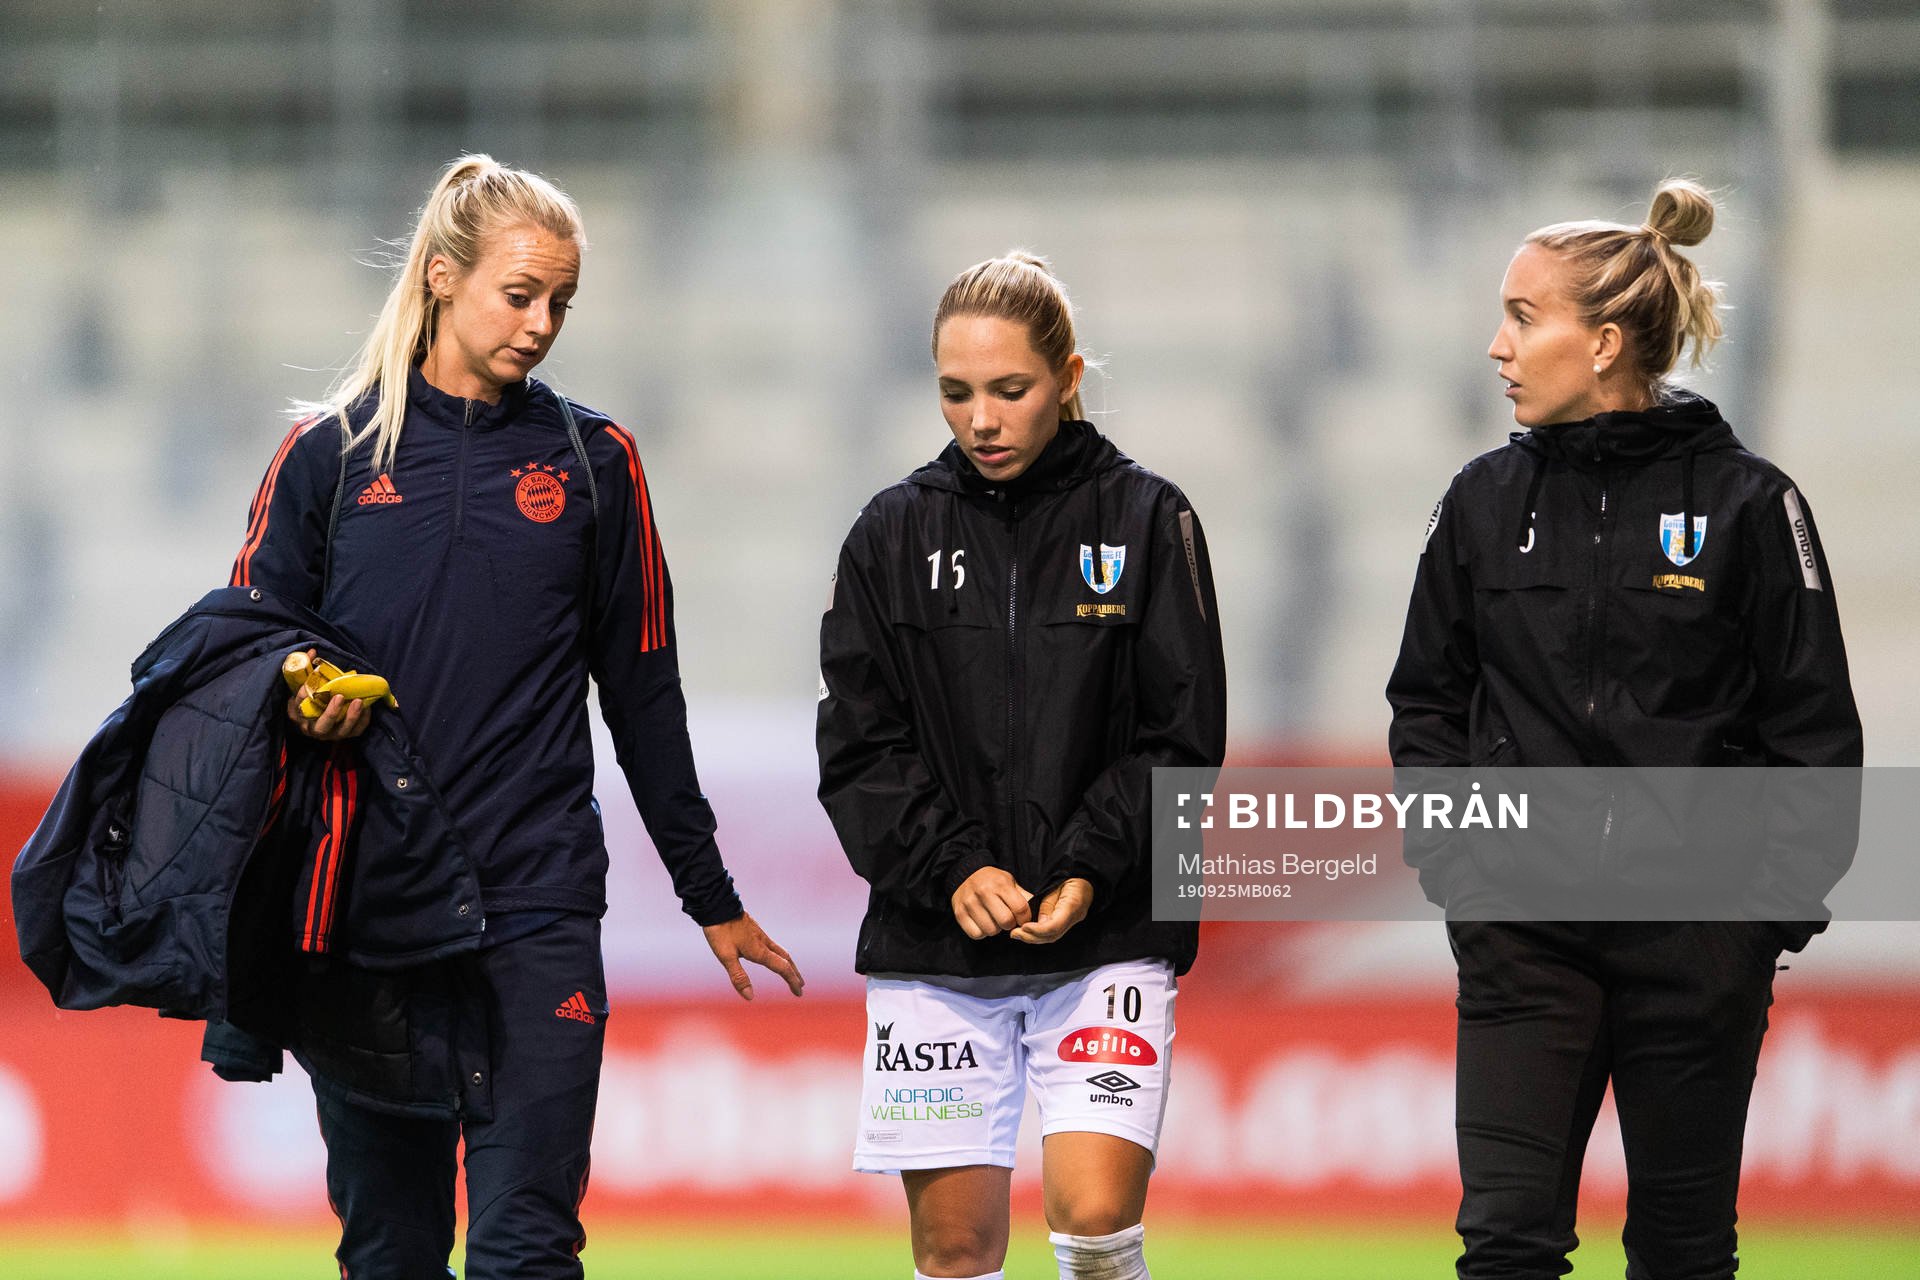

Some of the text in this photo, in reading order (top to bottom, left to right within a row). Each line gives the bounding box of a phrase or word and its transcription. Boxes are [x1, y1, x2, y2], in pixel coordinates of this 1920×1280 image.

[530, 475, 561, 496] BAYERN
[357, 492, 402, 505] adidas
[1794, 518, 1814, 569] umbro
[1076, 603, 1126, 618] KOPPARBERG
[1102, 982, 1142, 1024] 10
[555, 1007, 595, 1025] adidas
[1071, 1033, 1141, 1058] Agillo
[875, 1040, 979, 1072] RASTA
[884, 1087, 964, 1104] NORDIC
[1089, 1092, 1134, 1108] umbro
[870, 1102, 984, 1122] WELLNESS
